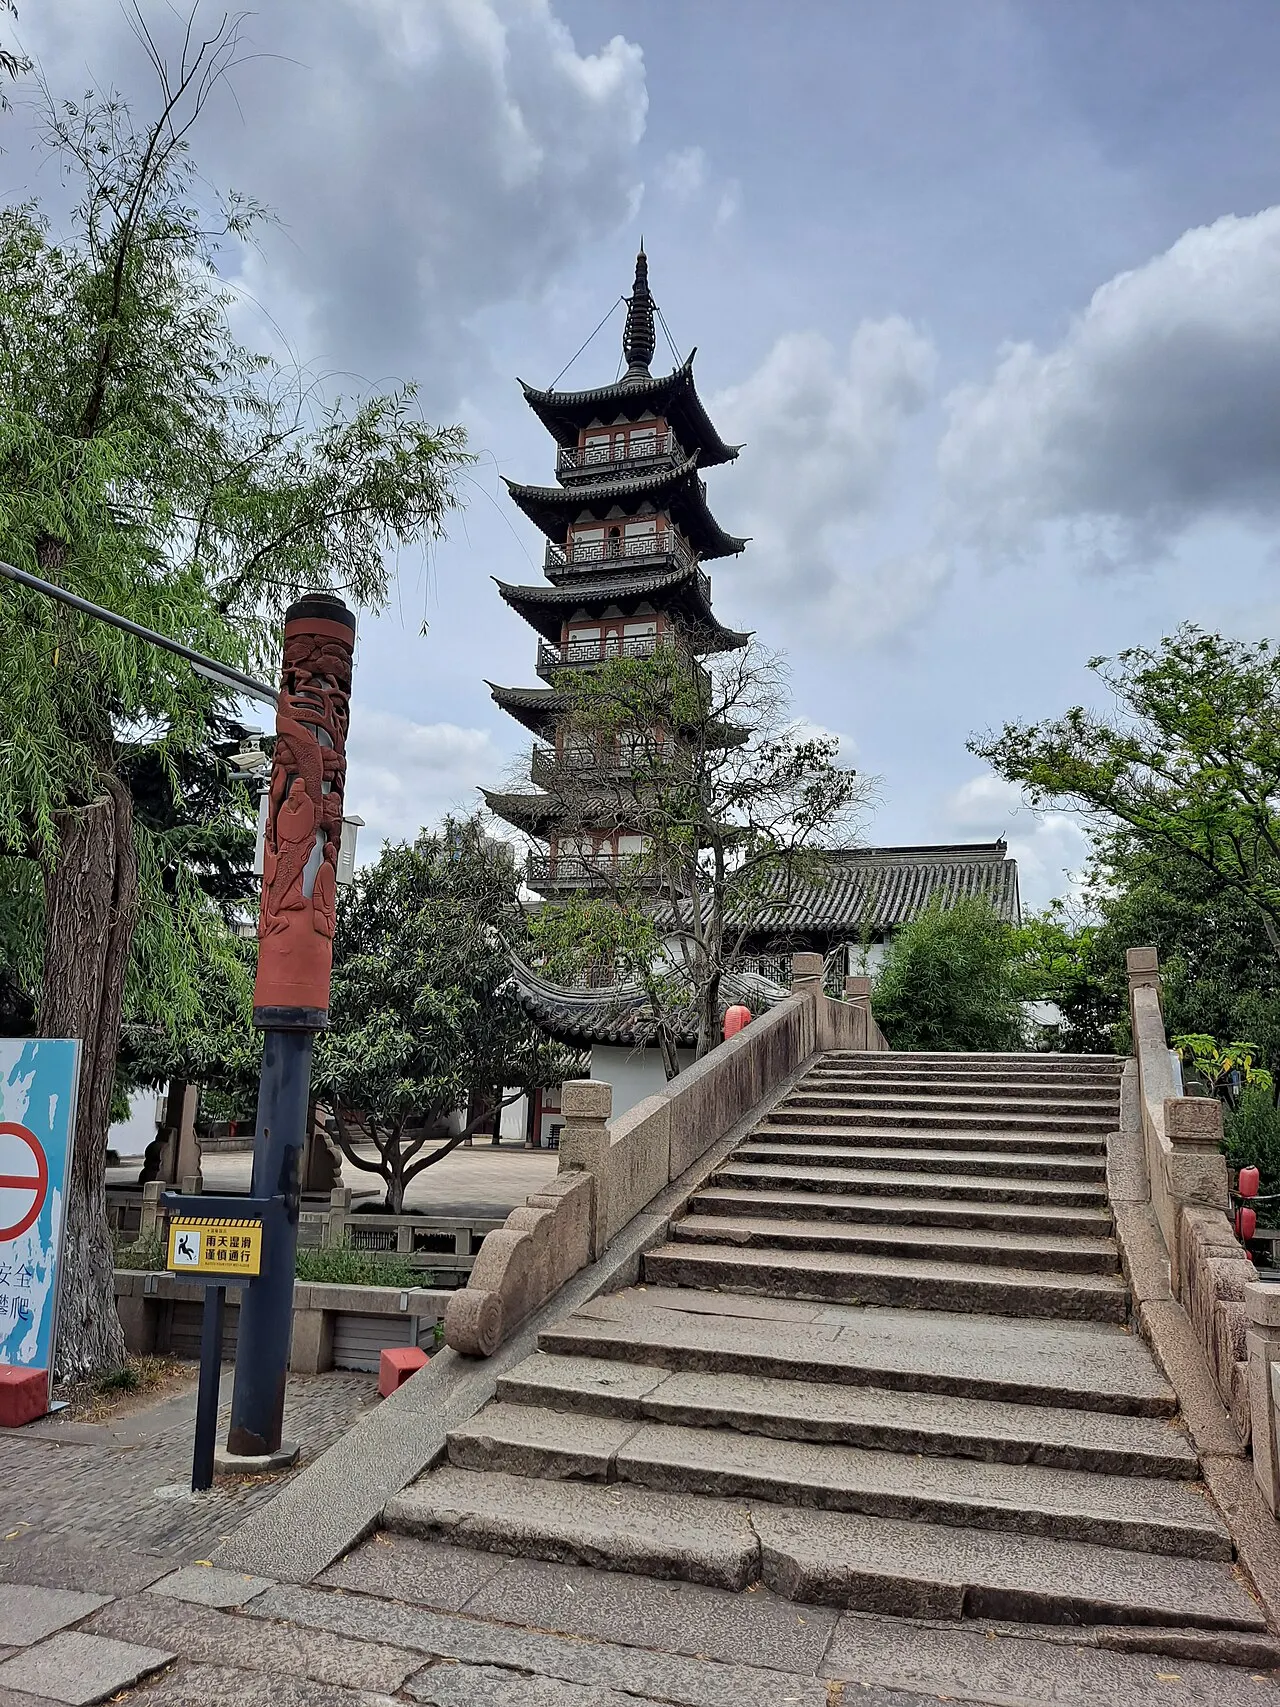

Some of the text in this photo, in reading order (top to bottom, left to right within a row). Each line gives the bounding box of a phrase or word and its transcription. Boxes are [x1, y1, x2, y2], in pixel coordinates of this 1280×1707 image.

[206, 1235, 251, 1248] 雨天湿滑
[205, 1249, 251, 1262] 谨慎通行
